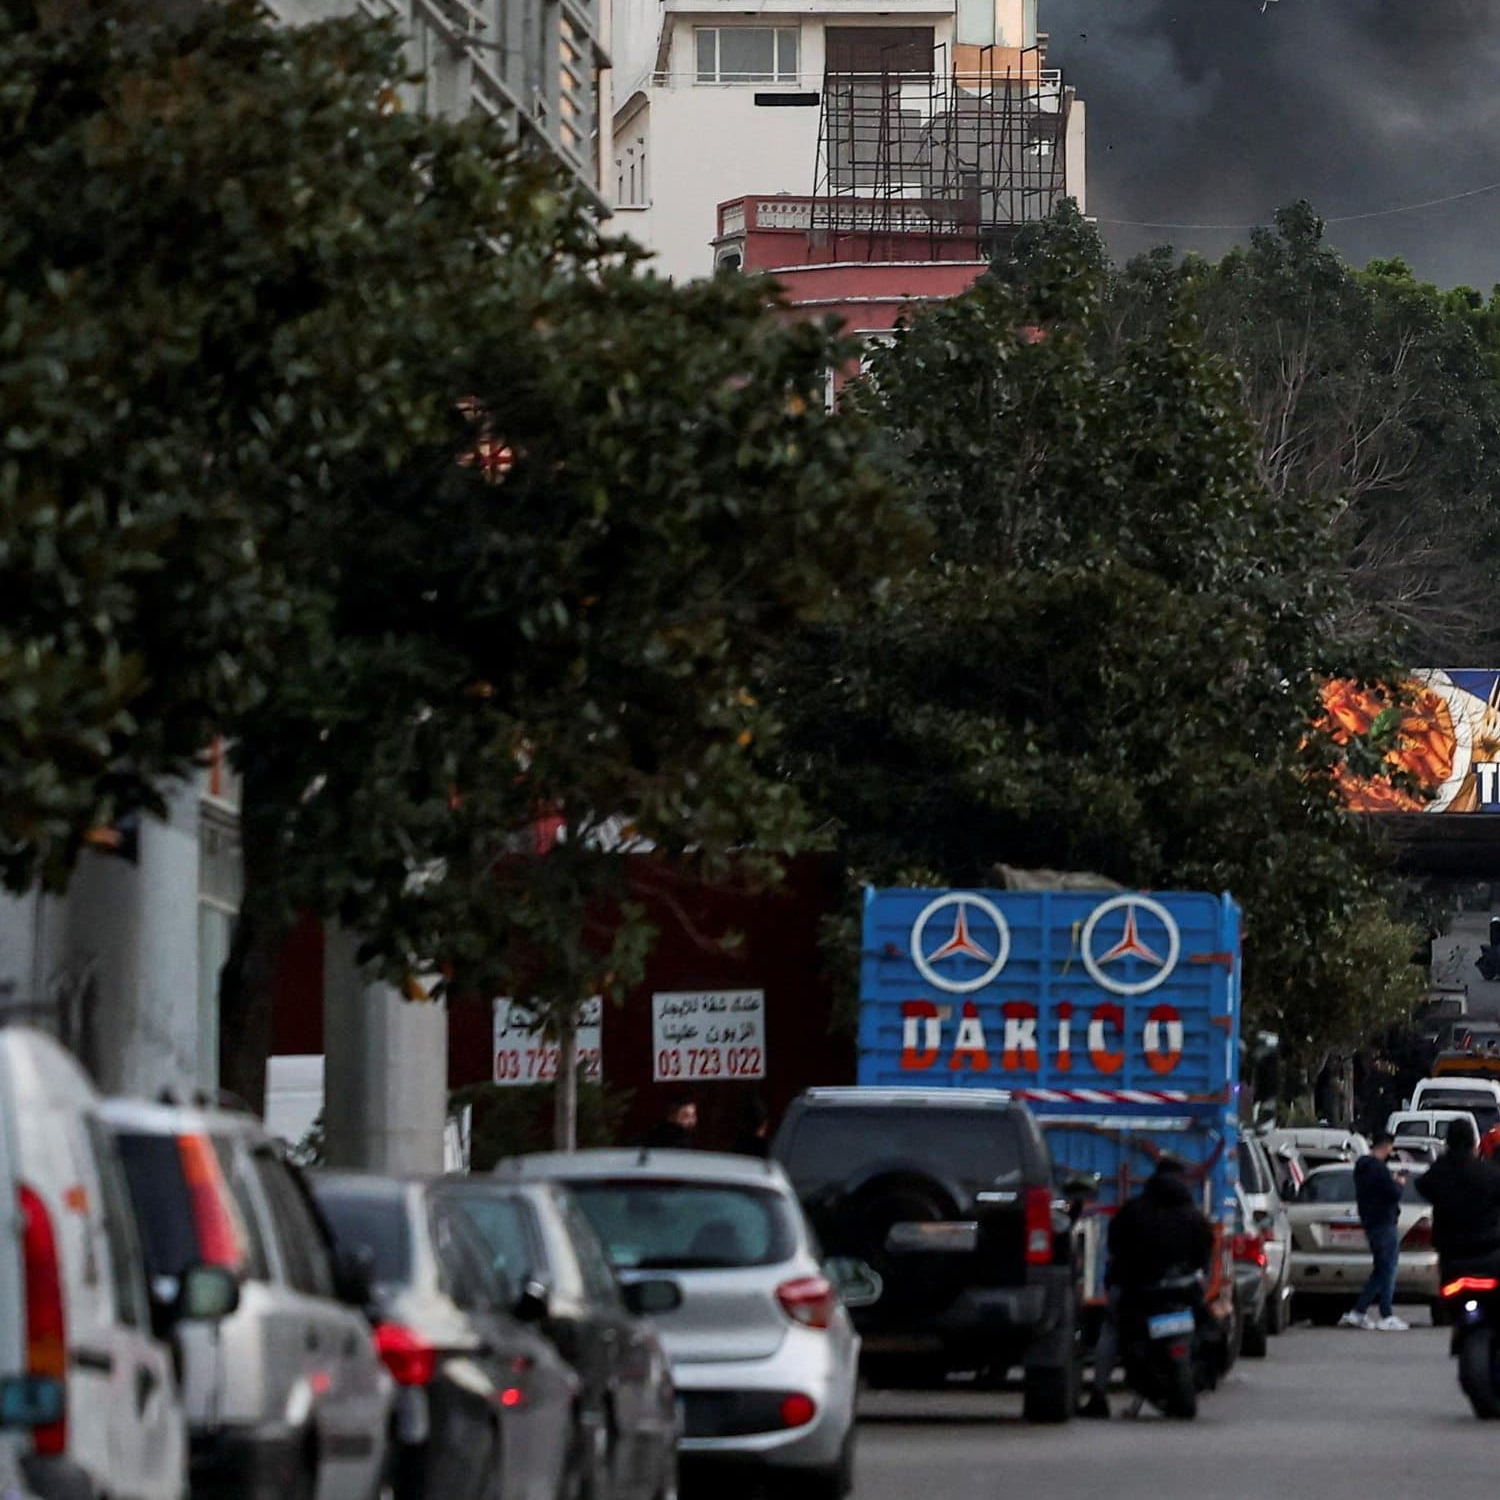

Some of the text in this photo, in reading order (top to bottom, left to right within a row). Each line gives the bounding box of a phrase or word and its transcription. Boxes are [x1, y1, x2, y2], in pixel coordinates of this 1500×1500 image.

[497, 1049, 520, 1079] 03
[658, 1046, 761, 1077] 03 723 022
